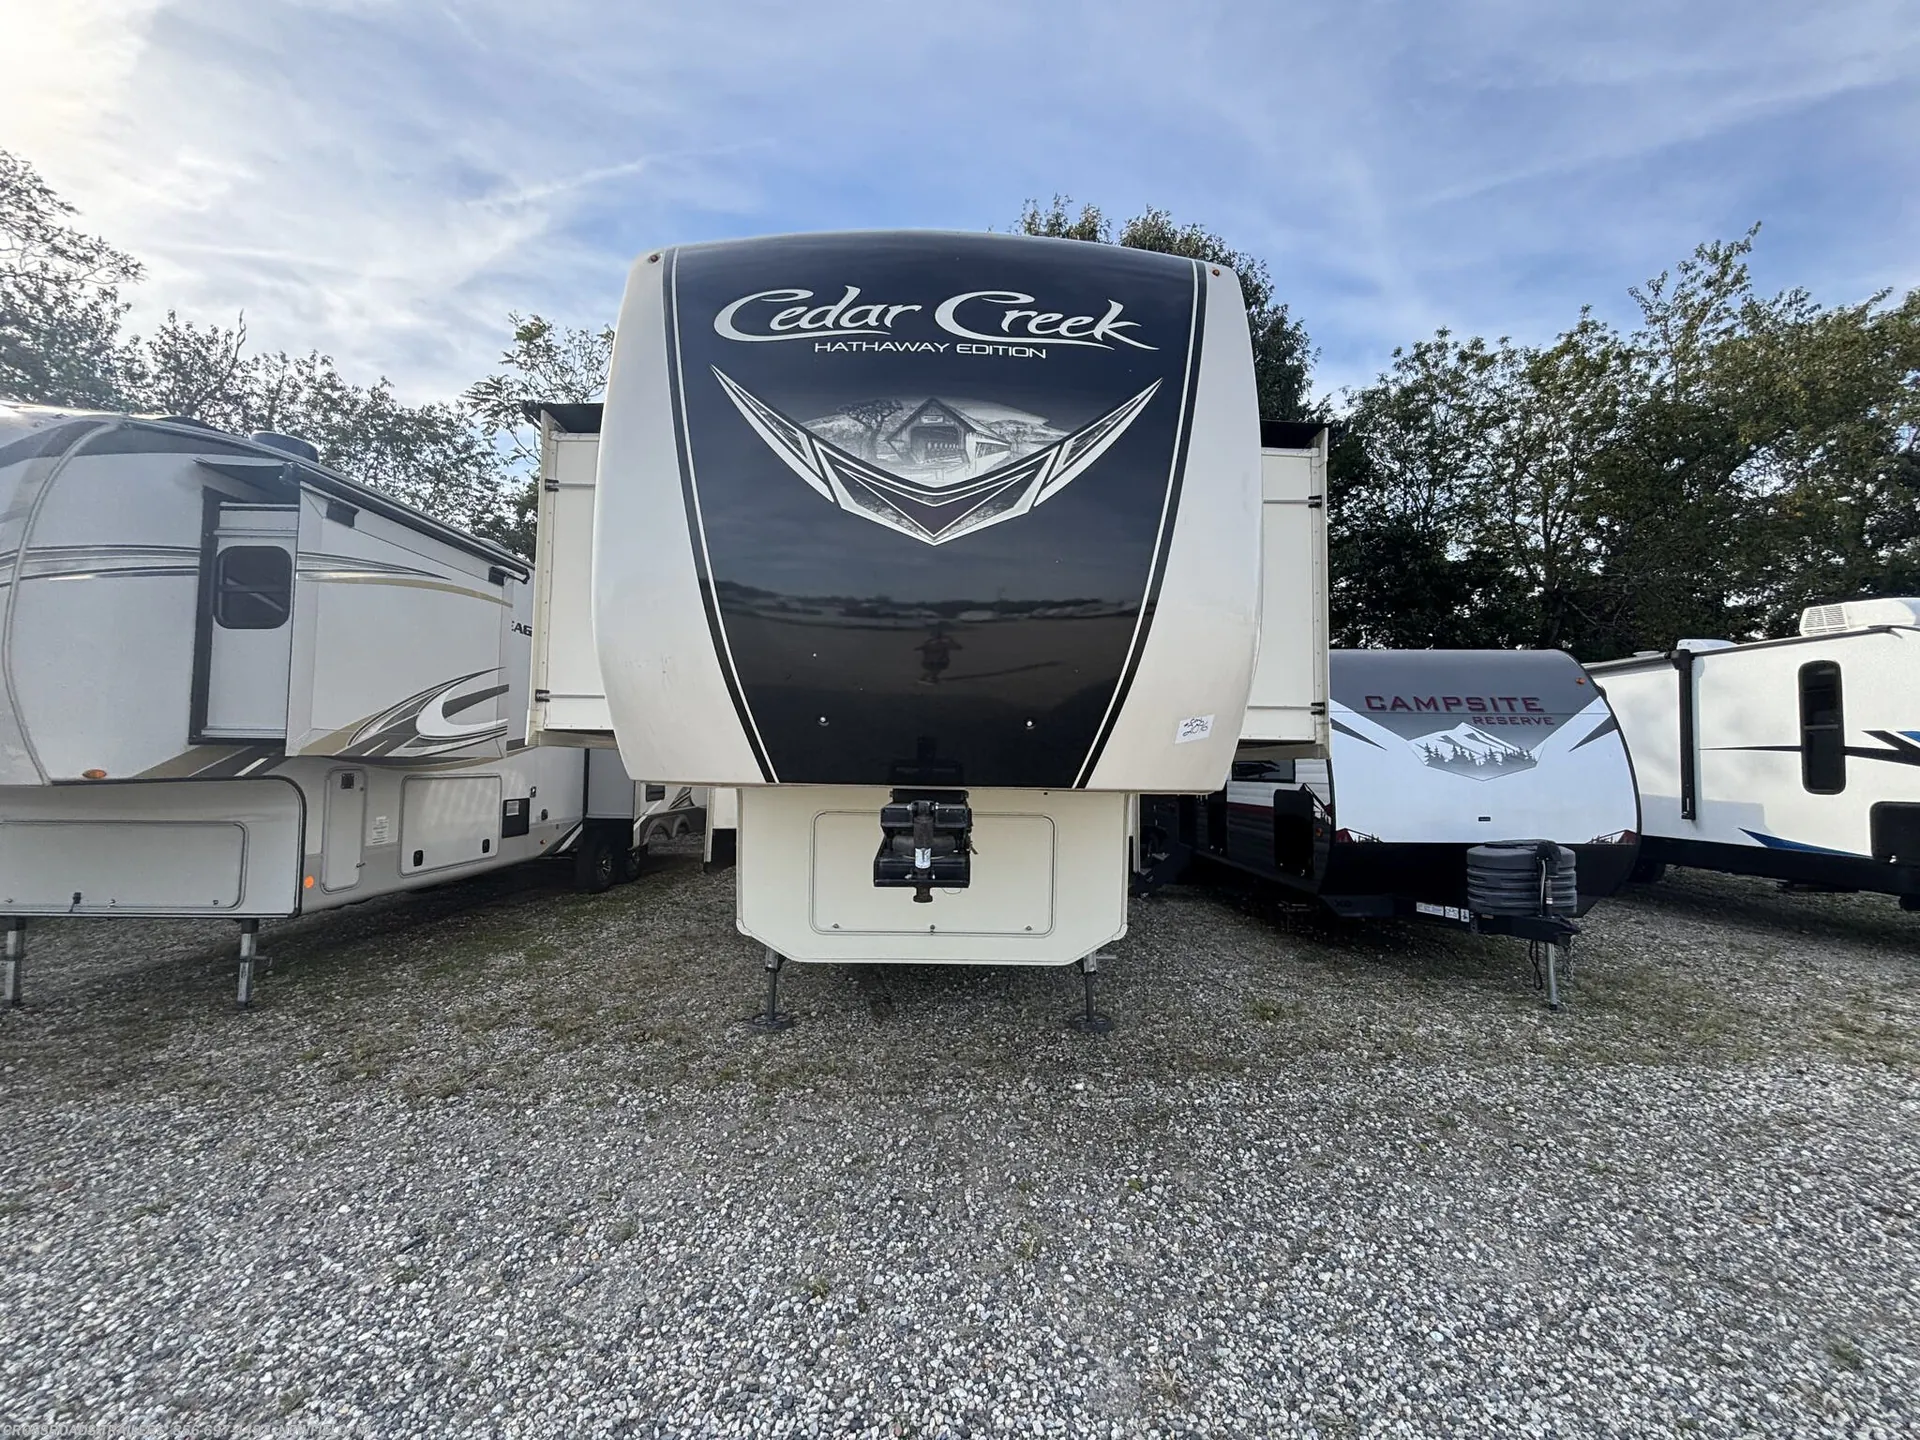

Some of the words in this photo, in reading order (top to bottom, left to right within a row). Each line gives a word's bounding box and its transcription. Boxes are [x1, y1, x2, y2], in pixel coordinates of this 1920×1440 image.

[712, 285, 922, 342] Cedar
[934, 290, 1160, 350] Creek
[814, 342, 951, 355] HATHAWAY
[956, 343, 1047, 359] EDITION
[1364, 695, 1546, 713] CAMPSITE
[1472, 716, 1555, 726] RESERVE
